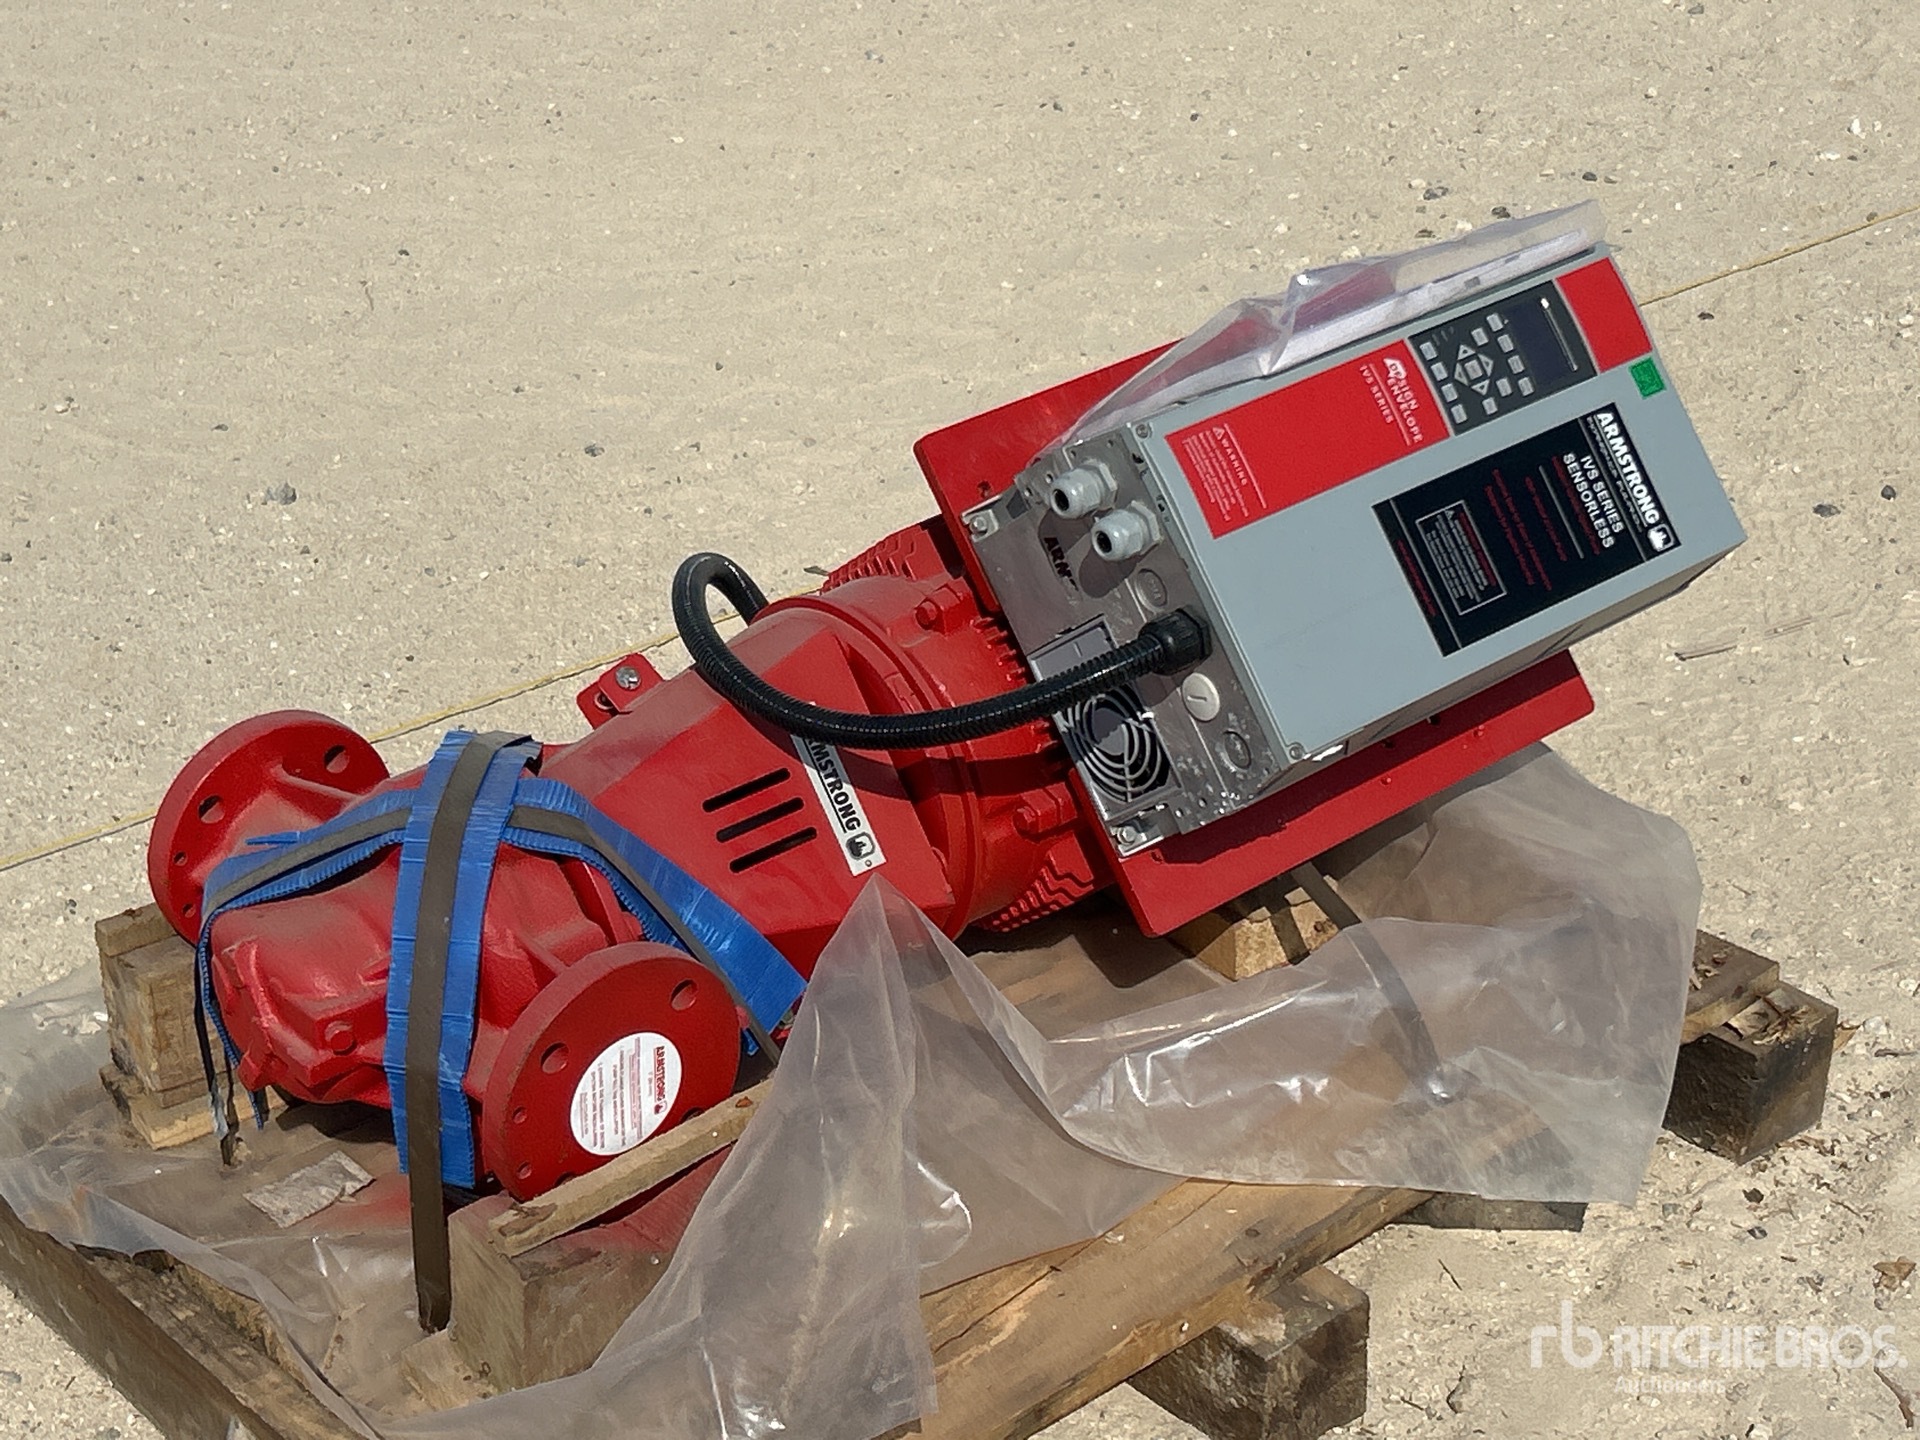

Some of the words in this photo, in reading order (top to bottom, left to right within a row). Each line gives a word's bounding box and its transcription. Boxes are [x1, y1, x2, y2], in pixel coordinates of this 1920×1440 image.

[1360, 364, 1374, 384] IVS
[1370, 385, 1395, 424] SERIES
[1386, 377, 1424, 443] ENVELOPE
[1221, 438, 1248, 486] WARNING
[1563, 453, 1615, 548] SENSORLESS
[1580, 455, 1600, 480] IVS
[1592, 481, 1624, 533] SERIES
[1597, 412, 1661, 524] ARMSTRONG
[808, 739, 862, 832] MSTRONG
